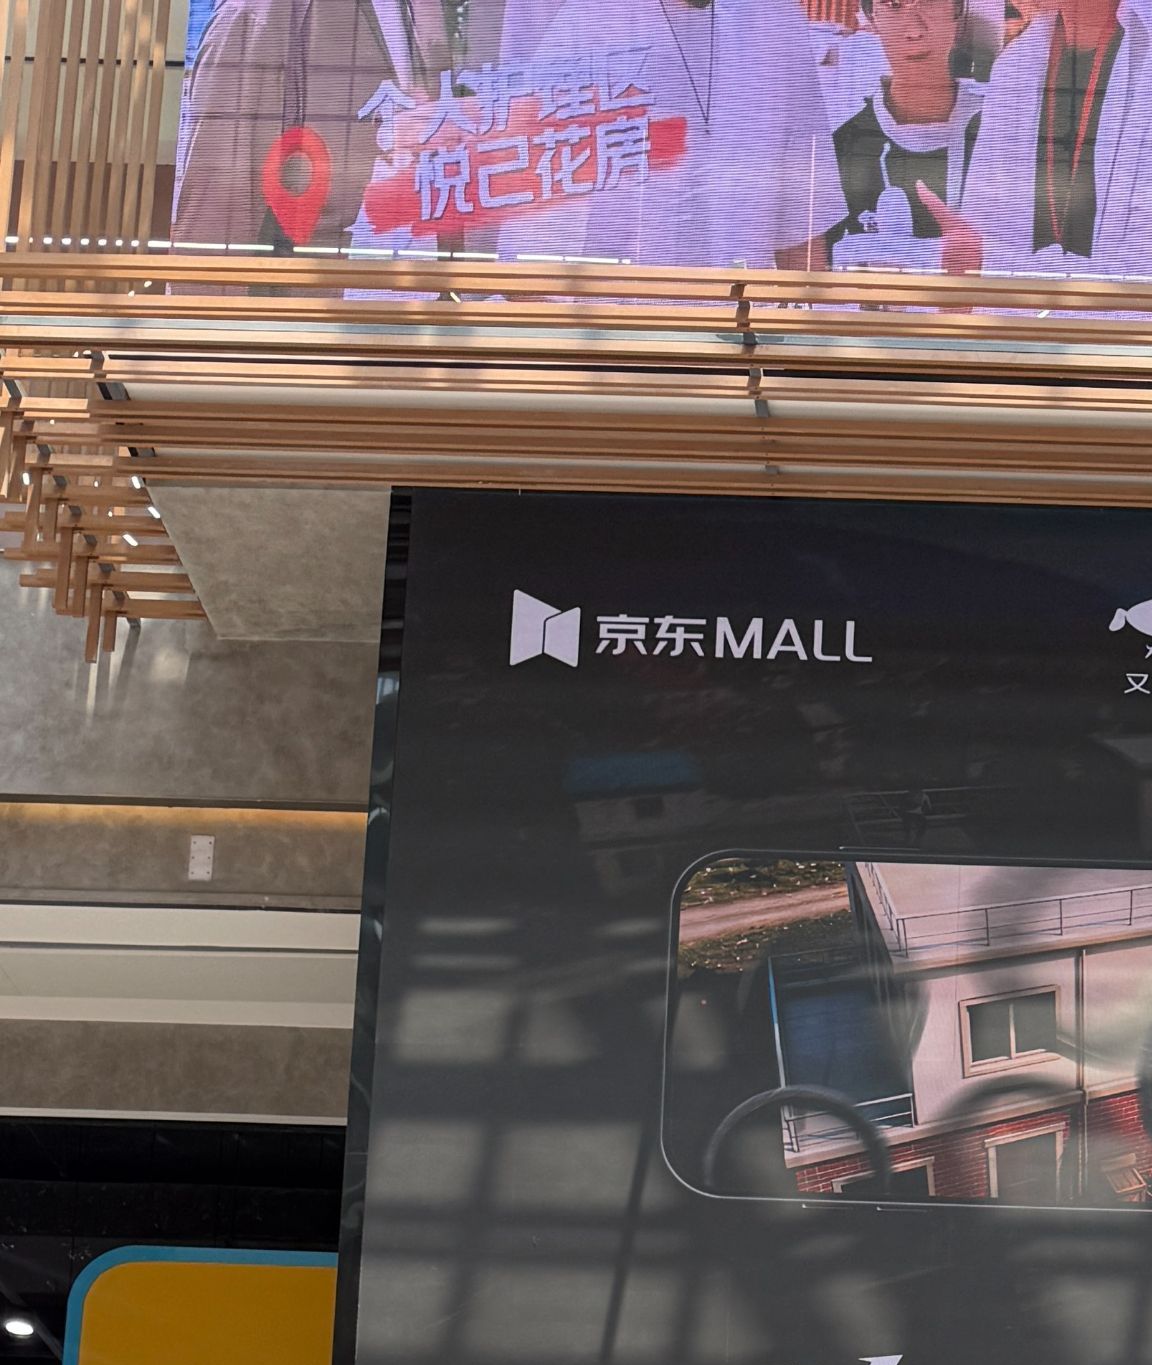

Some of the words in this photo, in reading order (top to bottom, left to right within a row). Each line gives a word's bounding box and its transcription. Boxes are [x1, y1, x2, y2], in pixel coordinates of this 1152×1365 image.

[415, 115, 651, 222] 悦己花房
[595, 614, 873, 663] 京东MALL
